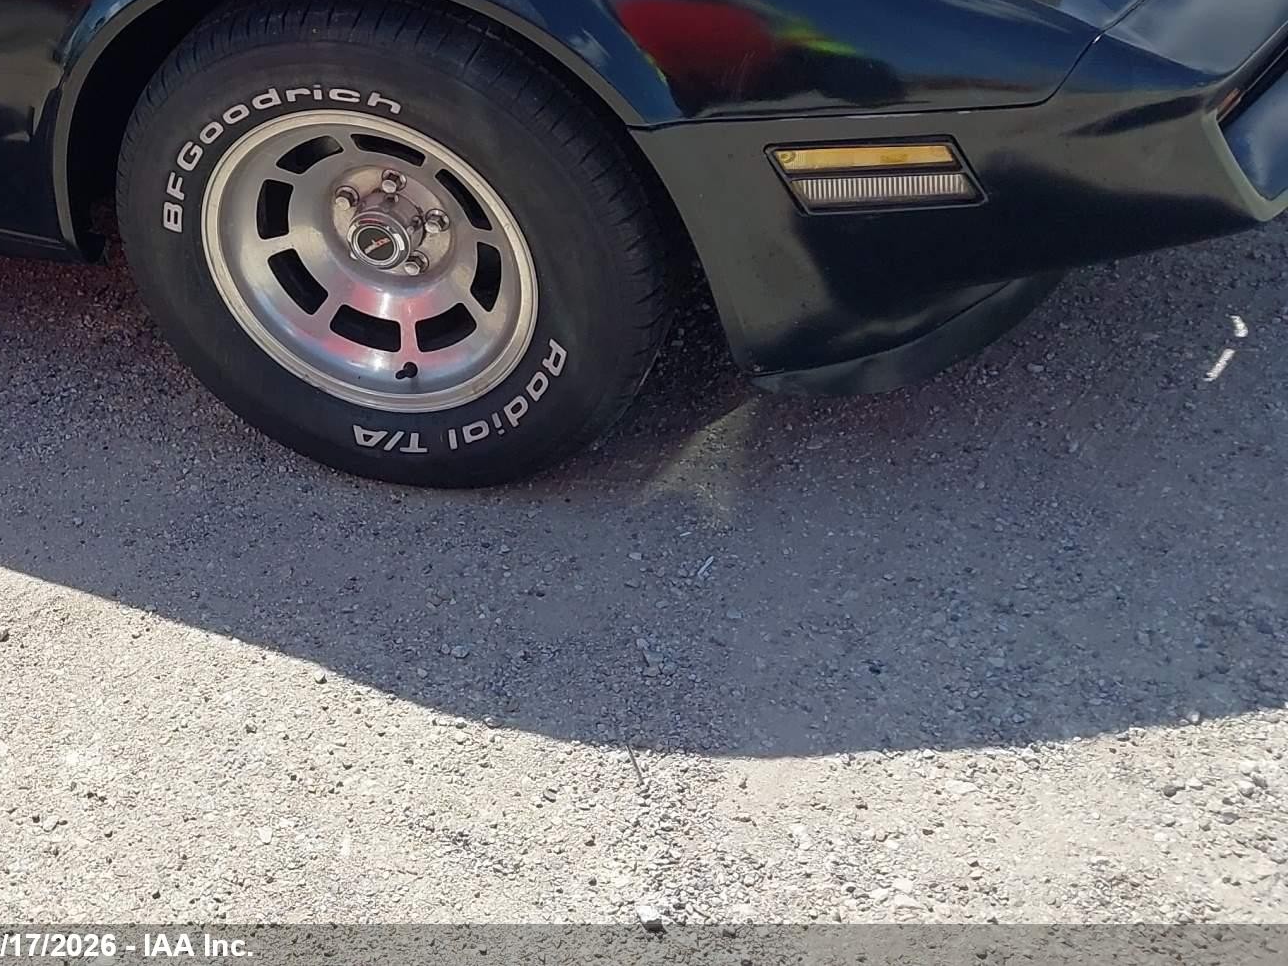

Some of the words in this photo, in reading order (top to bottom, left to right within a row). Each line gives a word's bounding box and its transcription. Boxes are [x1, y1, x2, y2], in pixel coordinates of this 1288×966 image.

[162, 84, 404, 234] BFGoodrich
[352, 425, 429, 454] T/A
[449, 338, 568, 451] Radial
